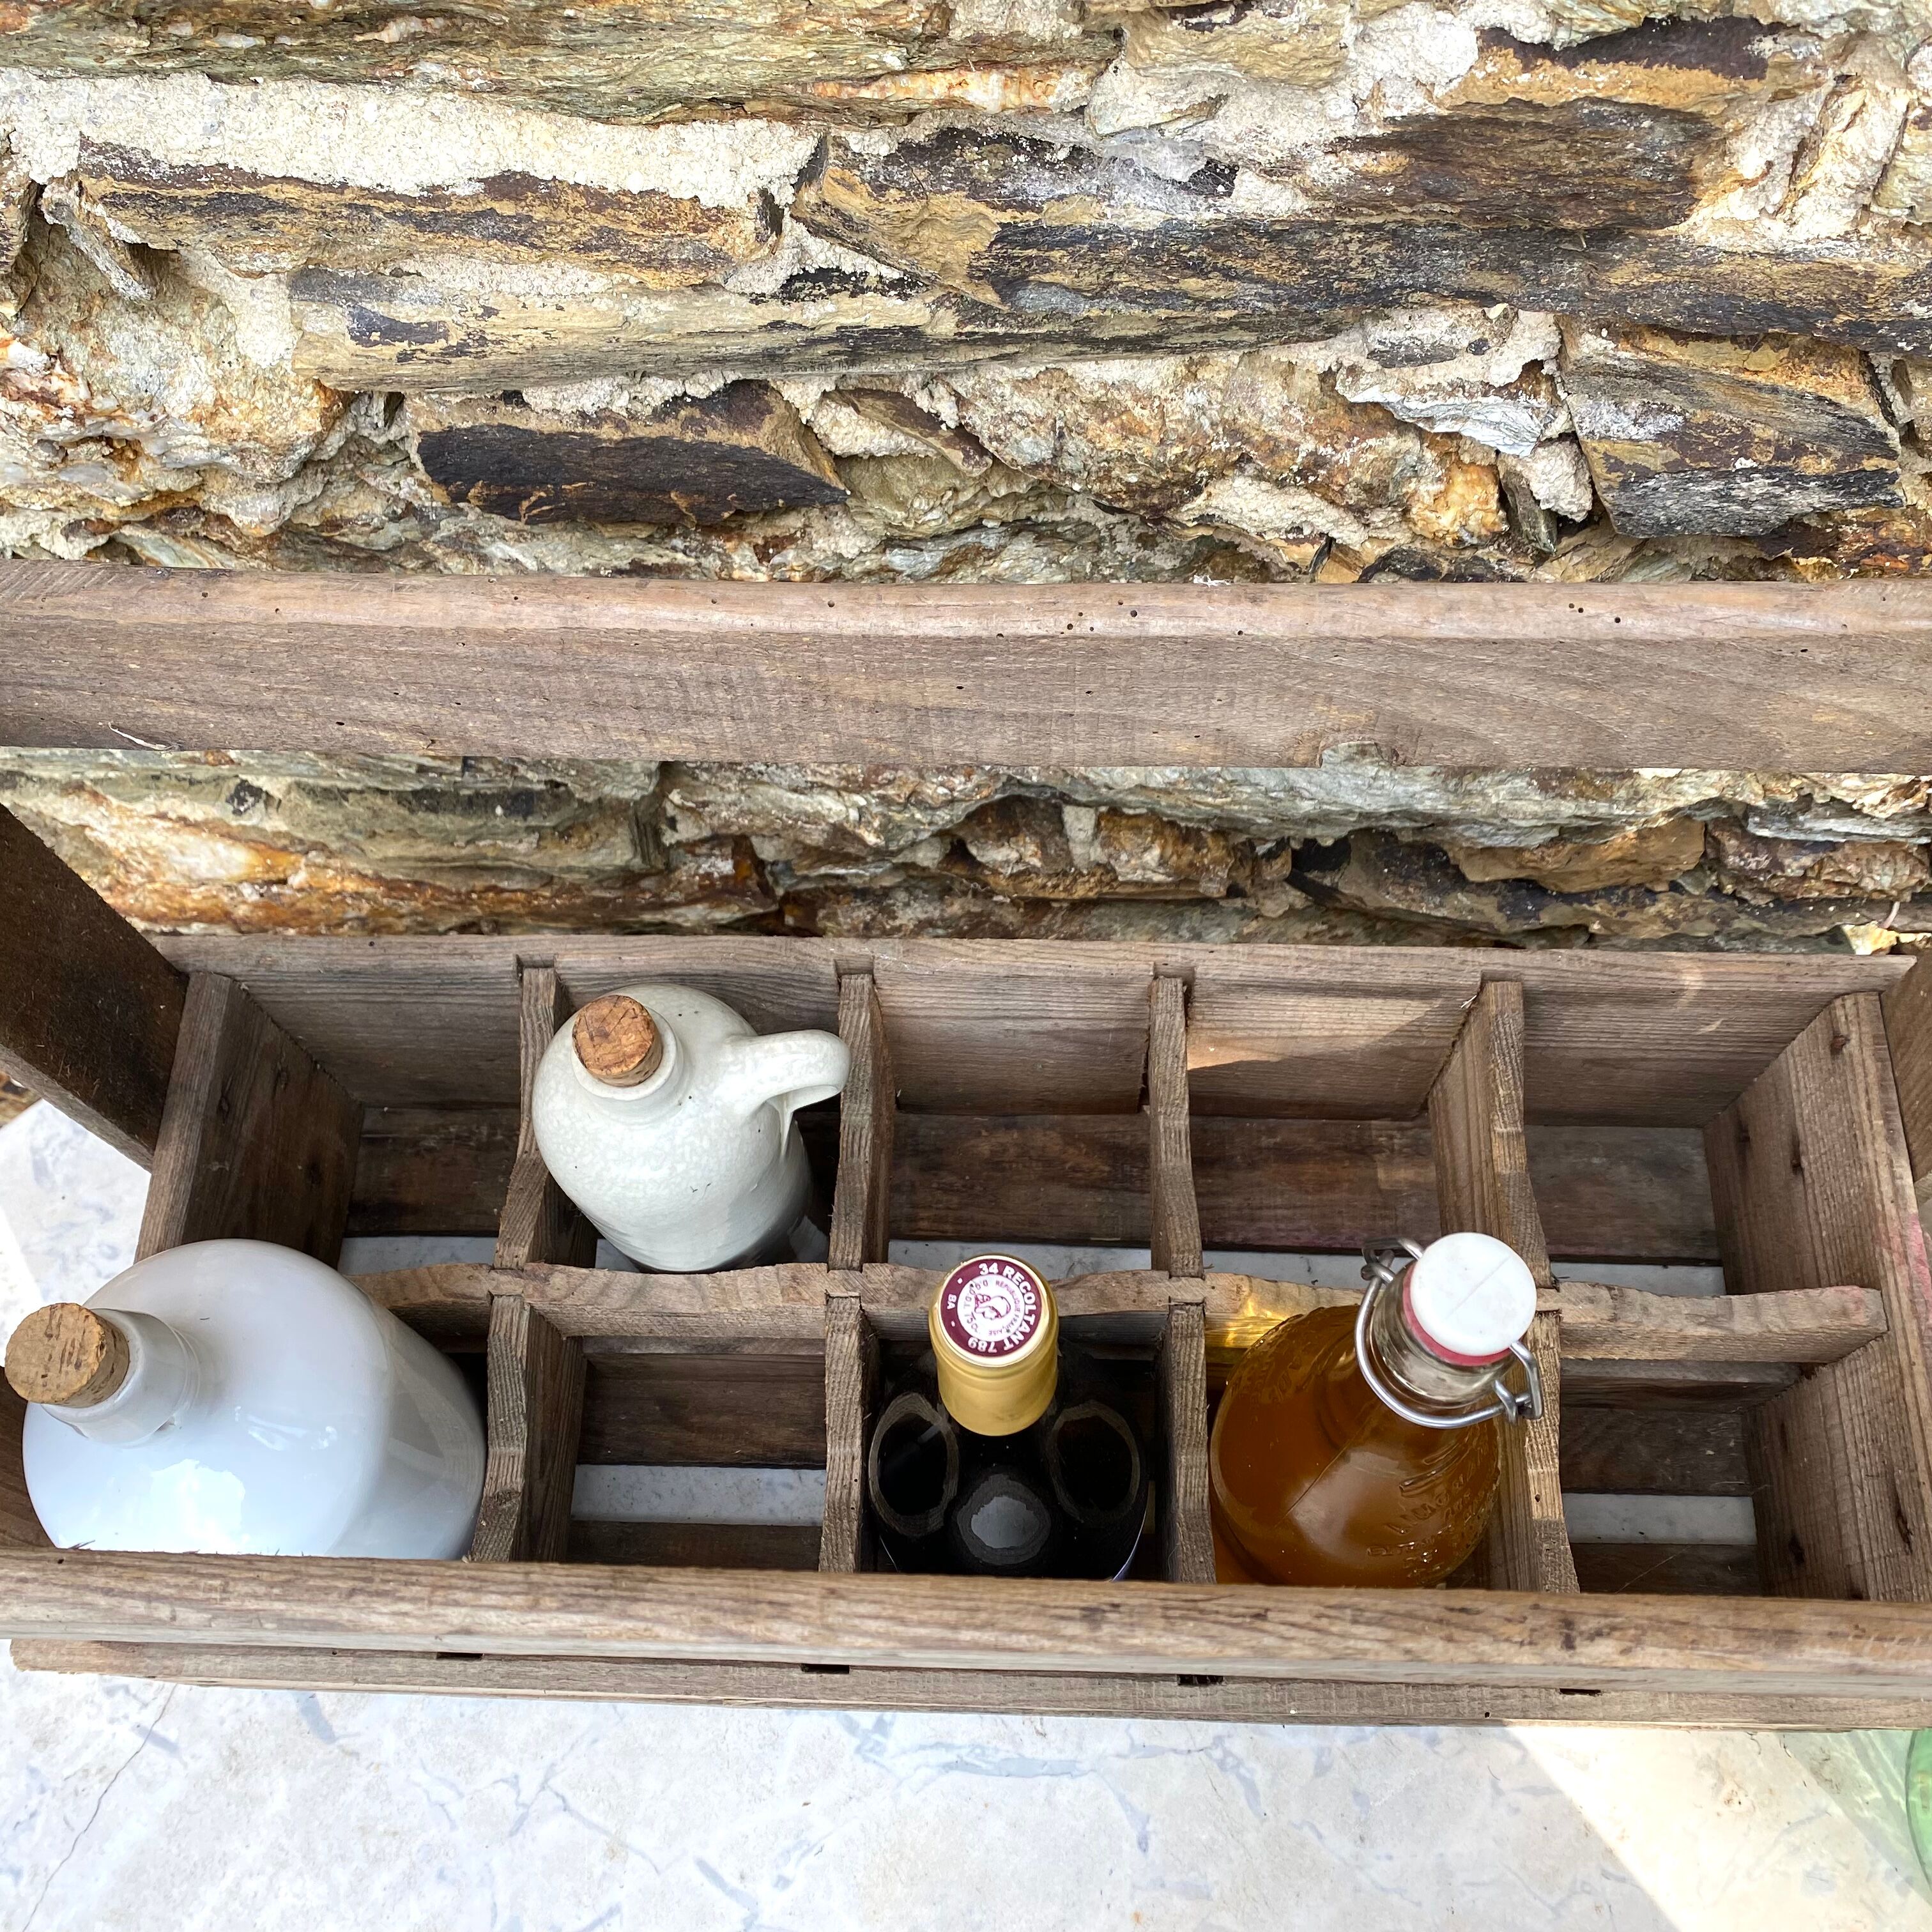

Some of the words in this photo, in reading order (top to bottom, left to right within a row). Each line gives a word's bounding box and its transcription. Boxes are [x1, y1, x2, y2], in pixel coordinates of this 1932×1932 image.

[979, 1262, 999, 1275] 34
[1002, 1265, 1036, 1351] RECOLTANT
[968, 1337, 997, 1353] 789
